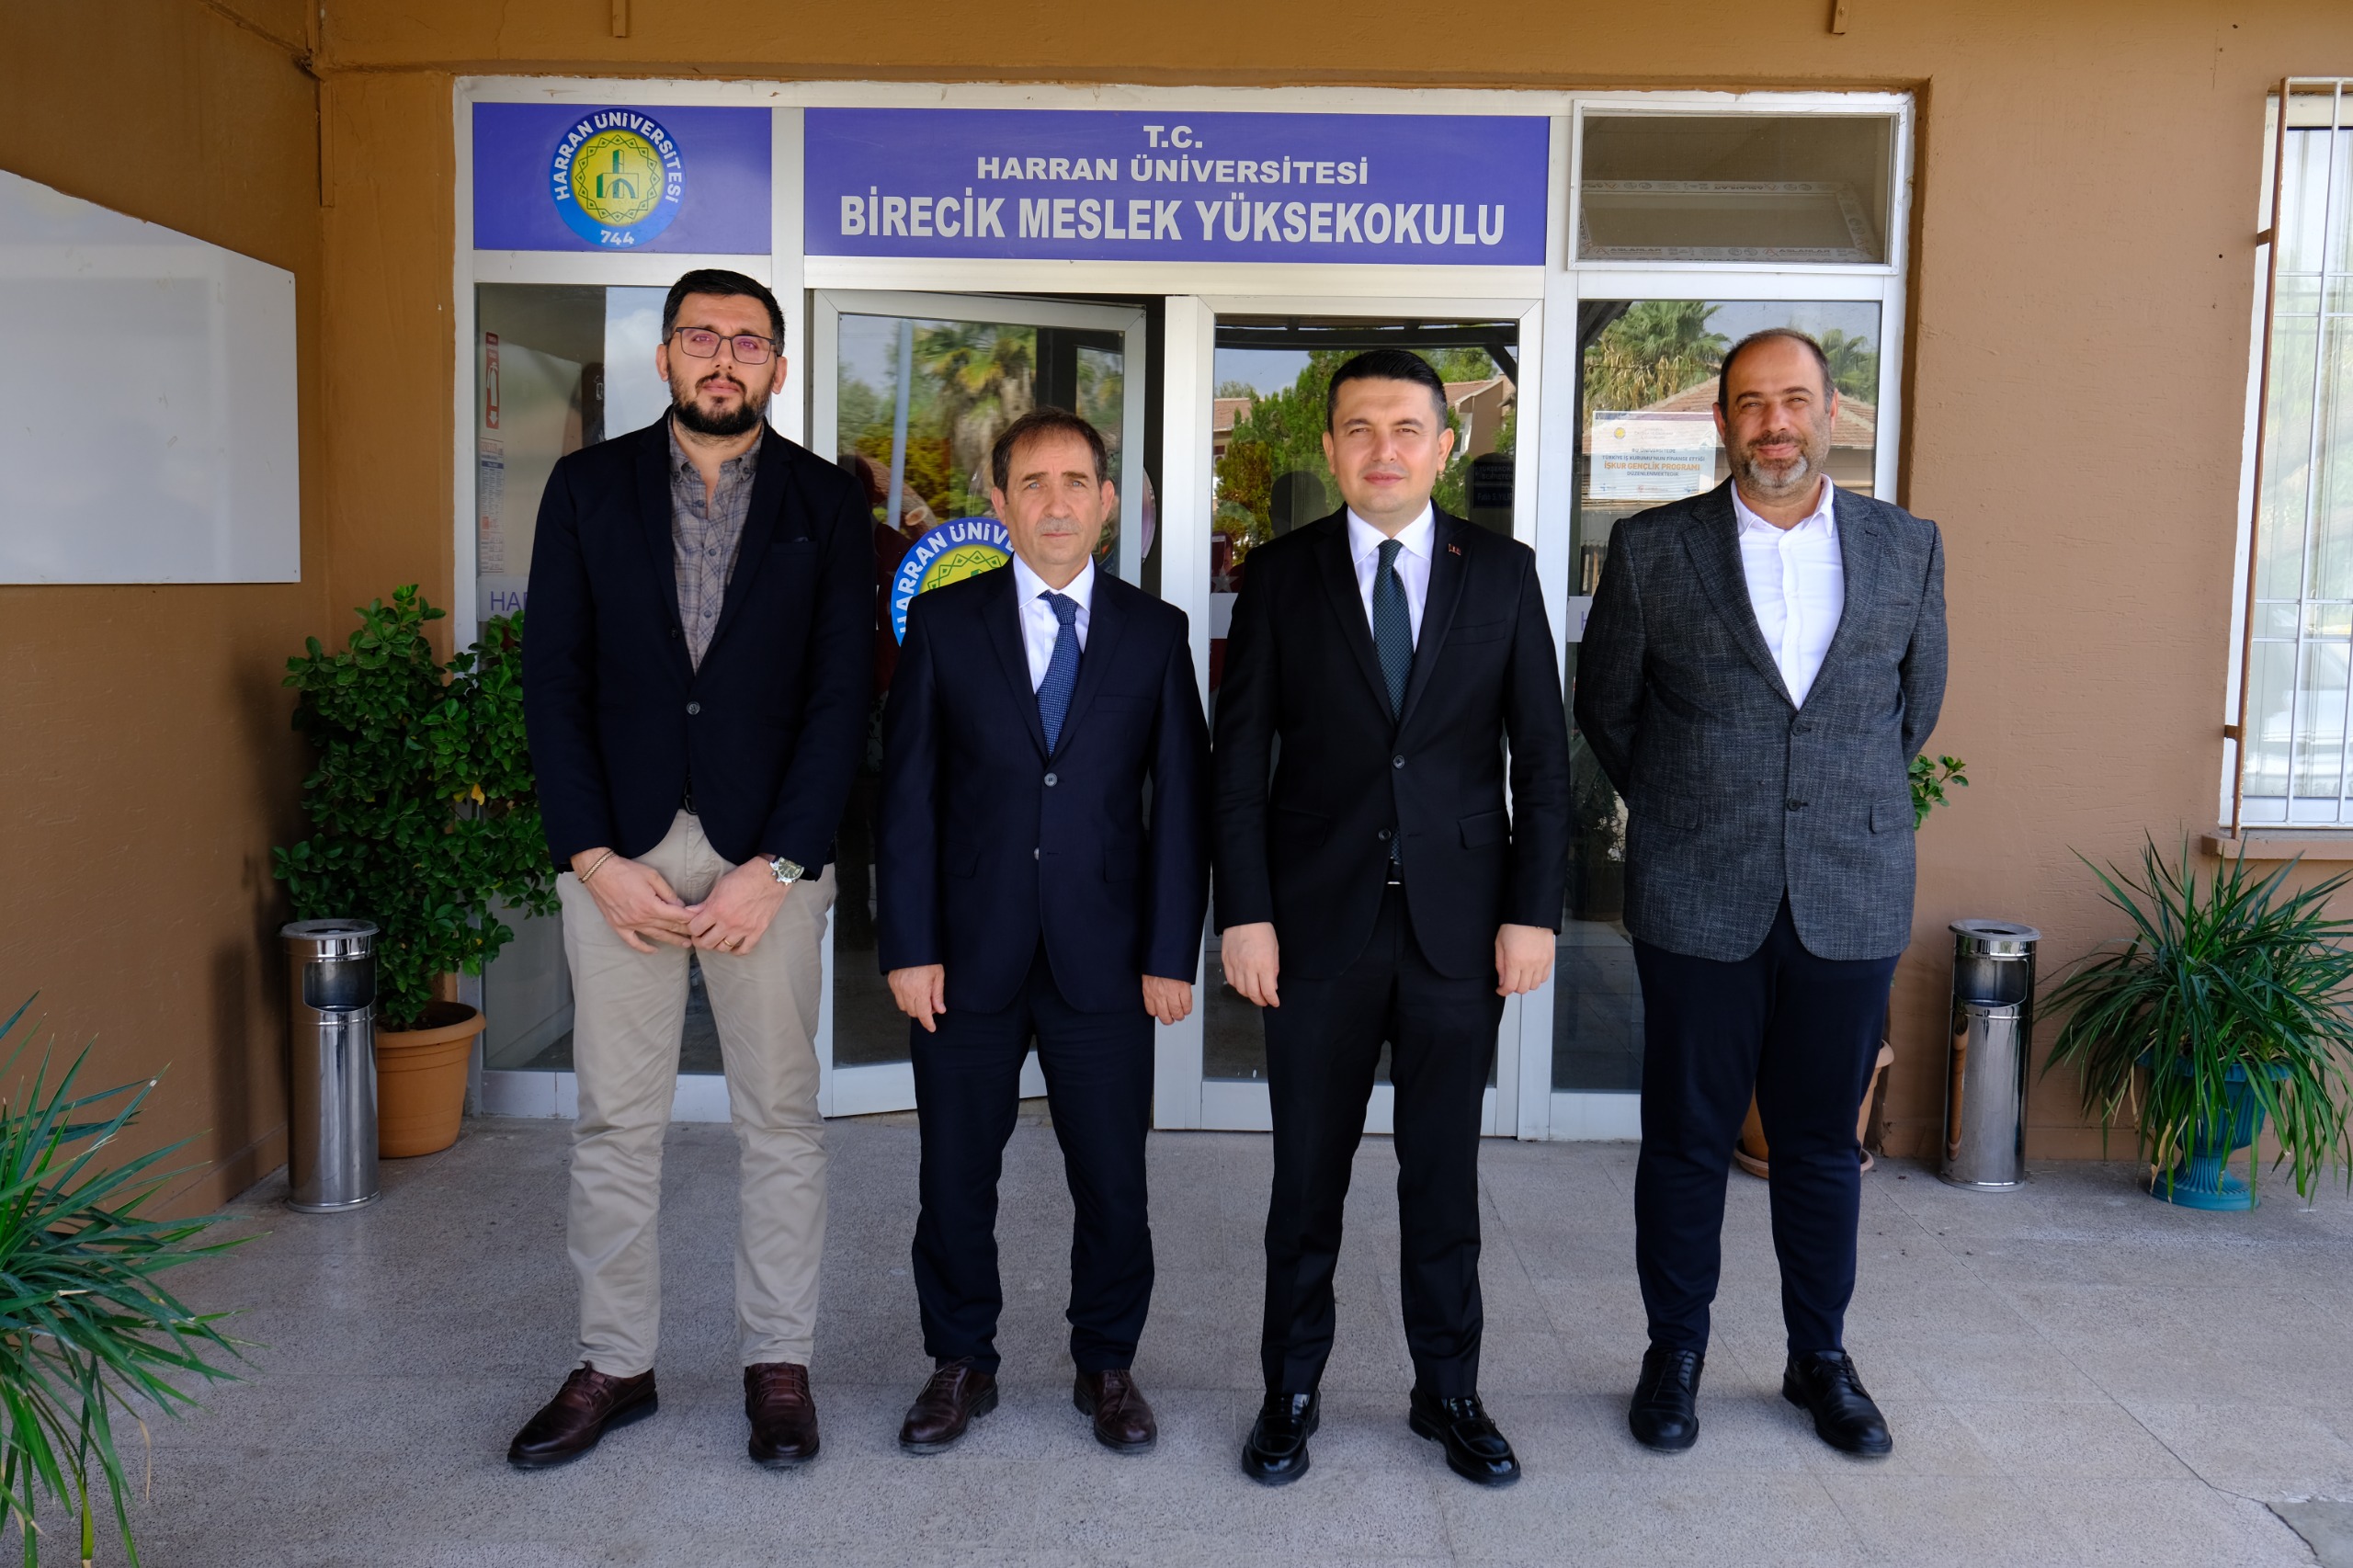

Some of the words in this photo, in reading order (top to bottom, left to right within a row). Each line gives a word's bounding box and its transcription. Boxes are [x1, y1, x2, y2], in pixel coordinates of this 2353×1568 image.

[1143, 125, 1203, 149] T.C.
[553, 120, 594, 200] HARRAN
[594, 112, 682, 203] ÜNİVERSİTESİ
[977, 156, 1118, 181] HARRAN
[1131, 153, 1368, 185] ÜNİVERSİTESİ
[841, 186, 1006, 238] BİRECİK
[1018, 198, 1183, 241] MESLEK
[1195, 192, 1505, 245] YÜKSEKOKULU
[600, 230, 635, 245] 744
[1628, 461, 1660, 472] GENÇLİK
[1661, 463, 1700, 472] PROGRAMI
